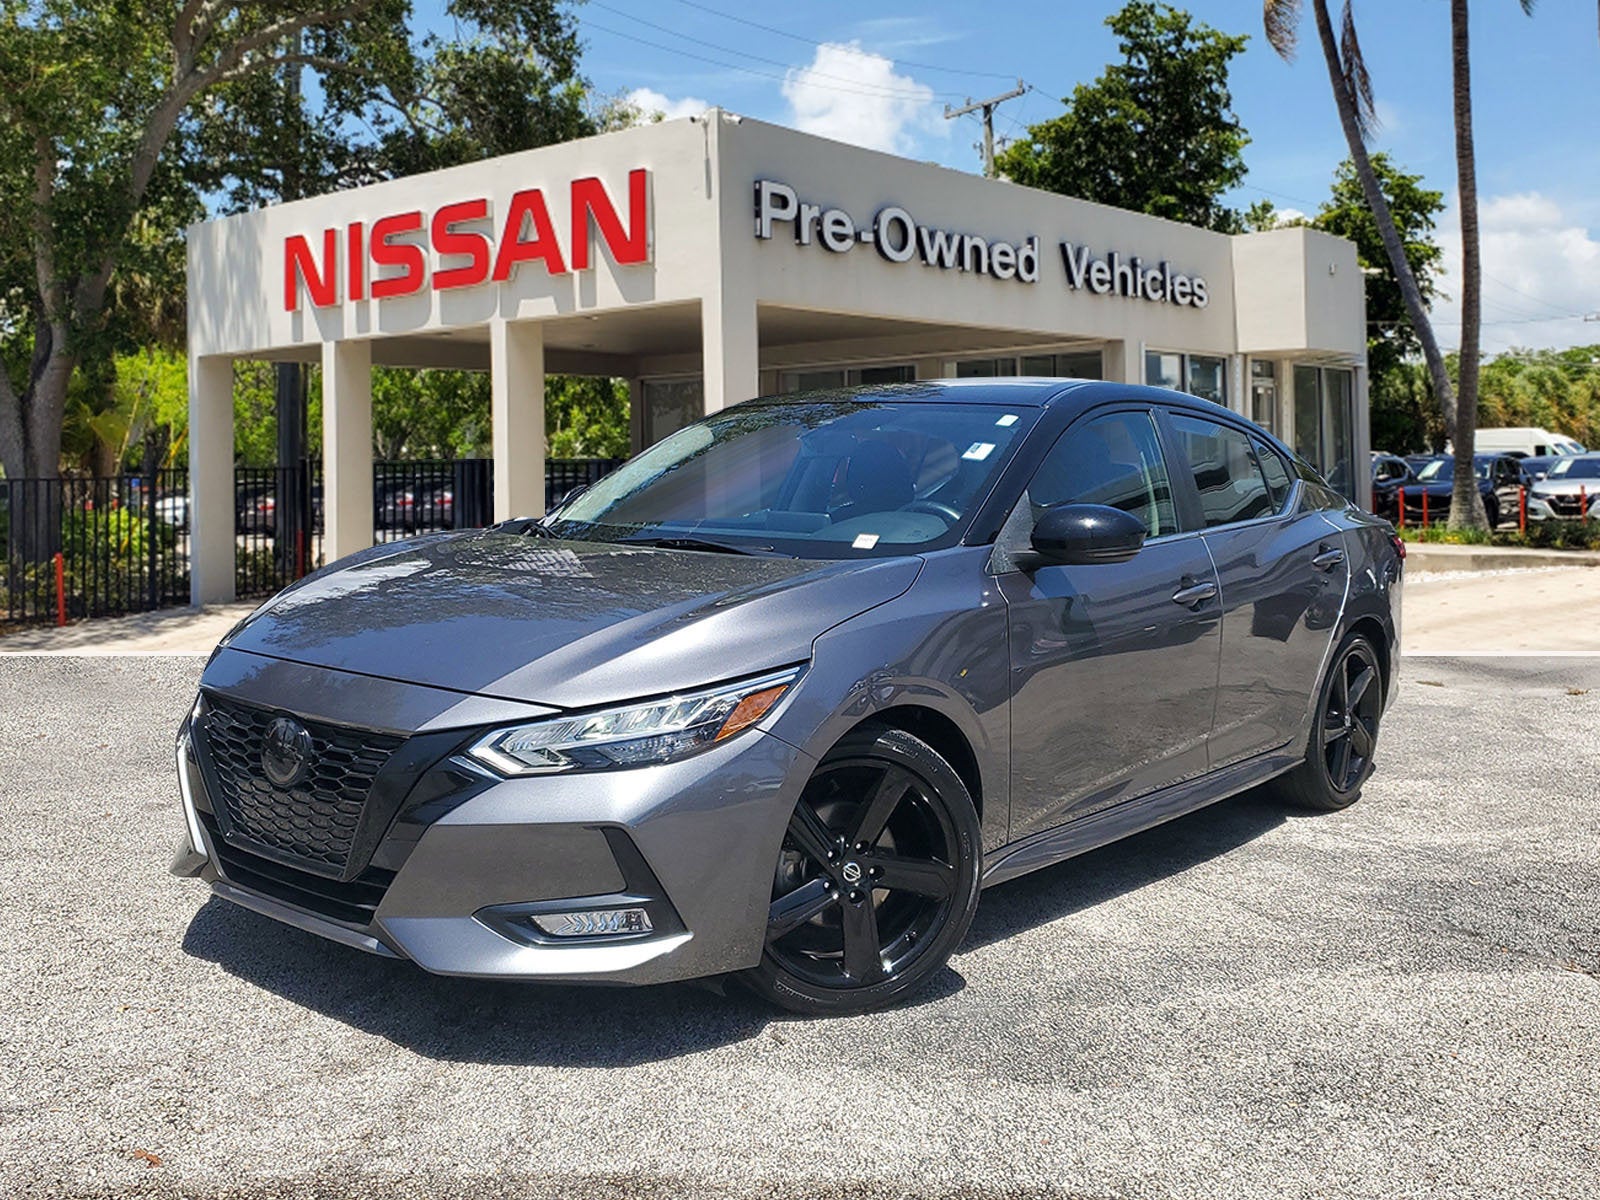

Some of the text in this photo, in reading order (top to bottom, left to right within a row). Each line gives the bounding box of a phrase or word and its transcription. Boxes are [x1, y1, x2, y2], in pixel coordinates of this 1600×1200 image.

[284, 169, 648, 311] NISSAN
[755, 180, 1209, 308] Pre-Owned Vehicles
